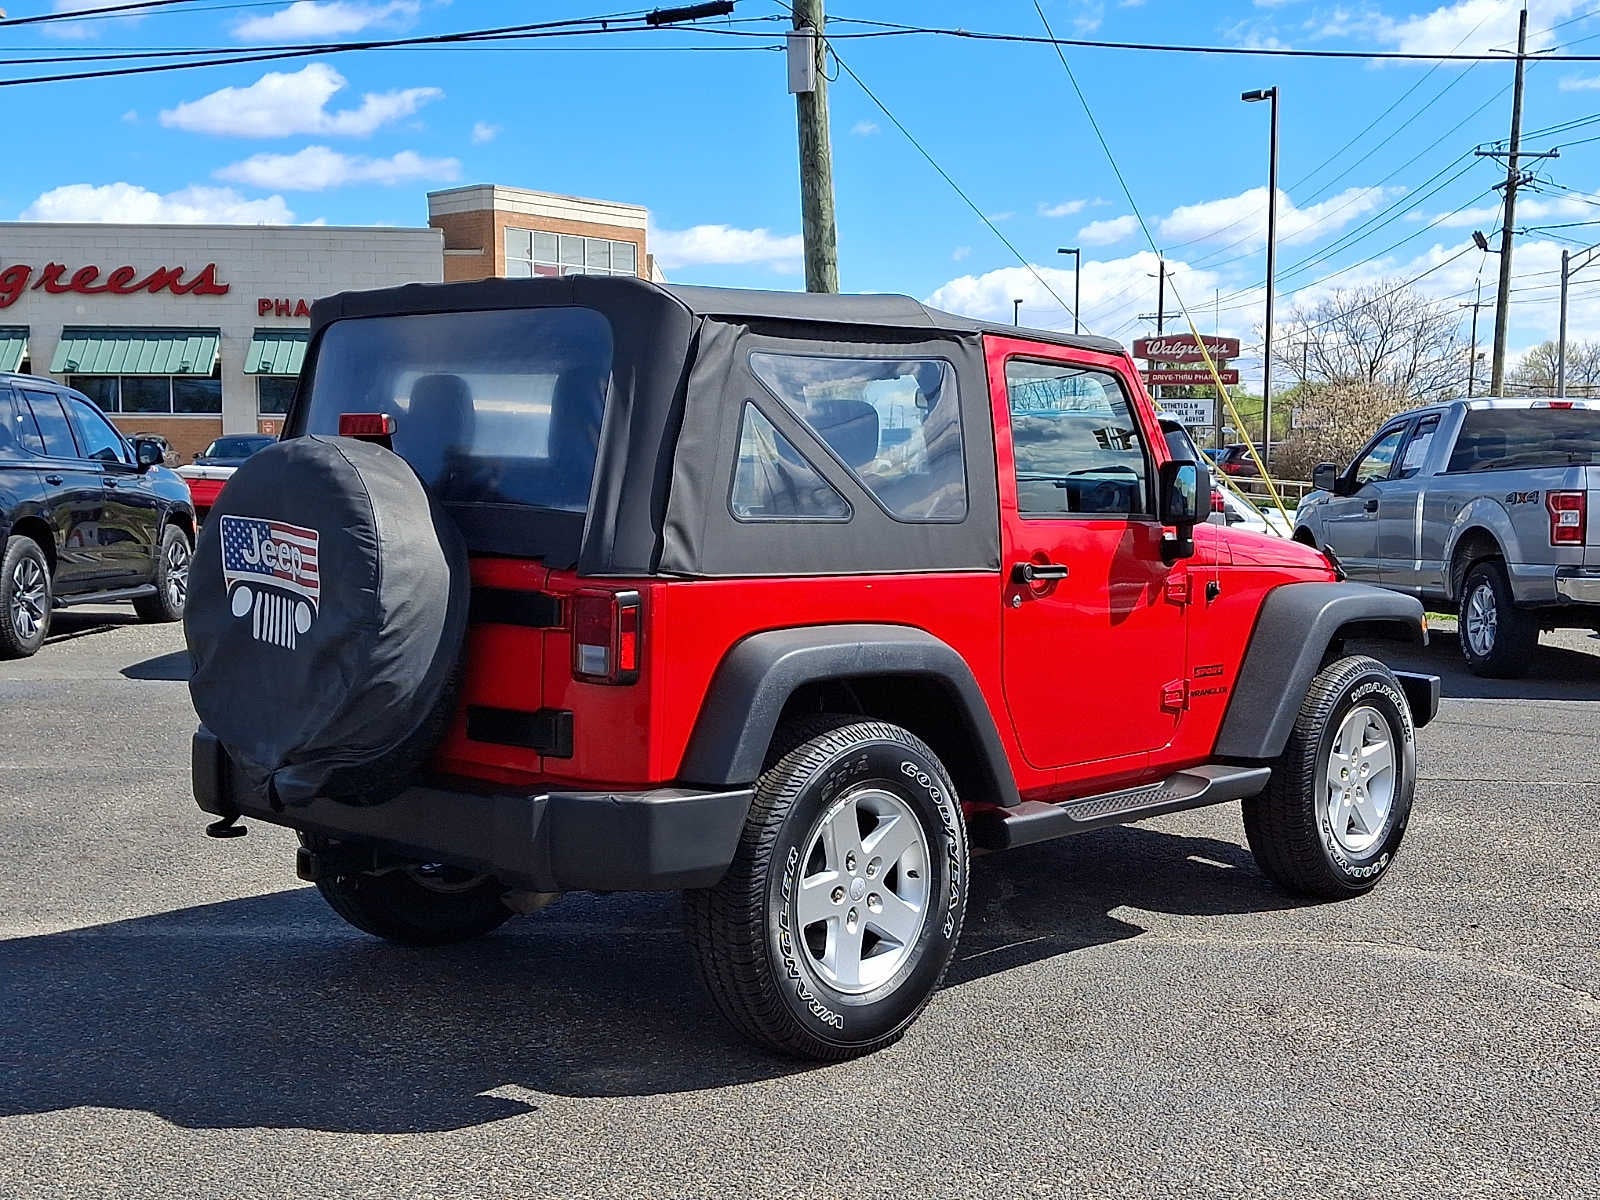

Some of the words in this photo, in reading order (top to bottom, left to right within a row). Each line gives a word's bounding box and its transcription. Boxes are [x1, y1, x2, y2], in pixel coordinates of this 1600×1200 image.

[0, 262, 230, 308] greens
[242, 527, 303, 581] Jeep
[1190, 687, 1227, 697] WRANGLER
[1351, 681, 1412, 744] WRANGLER
[900, 760, 962, 939] GOODYEAR
[778, 846, 844, 1030] WRANGLER
